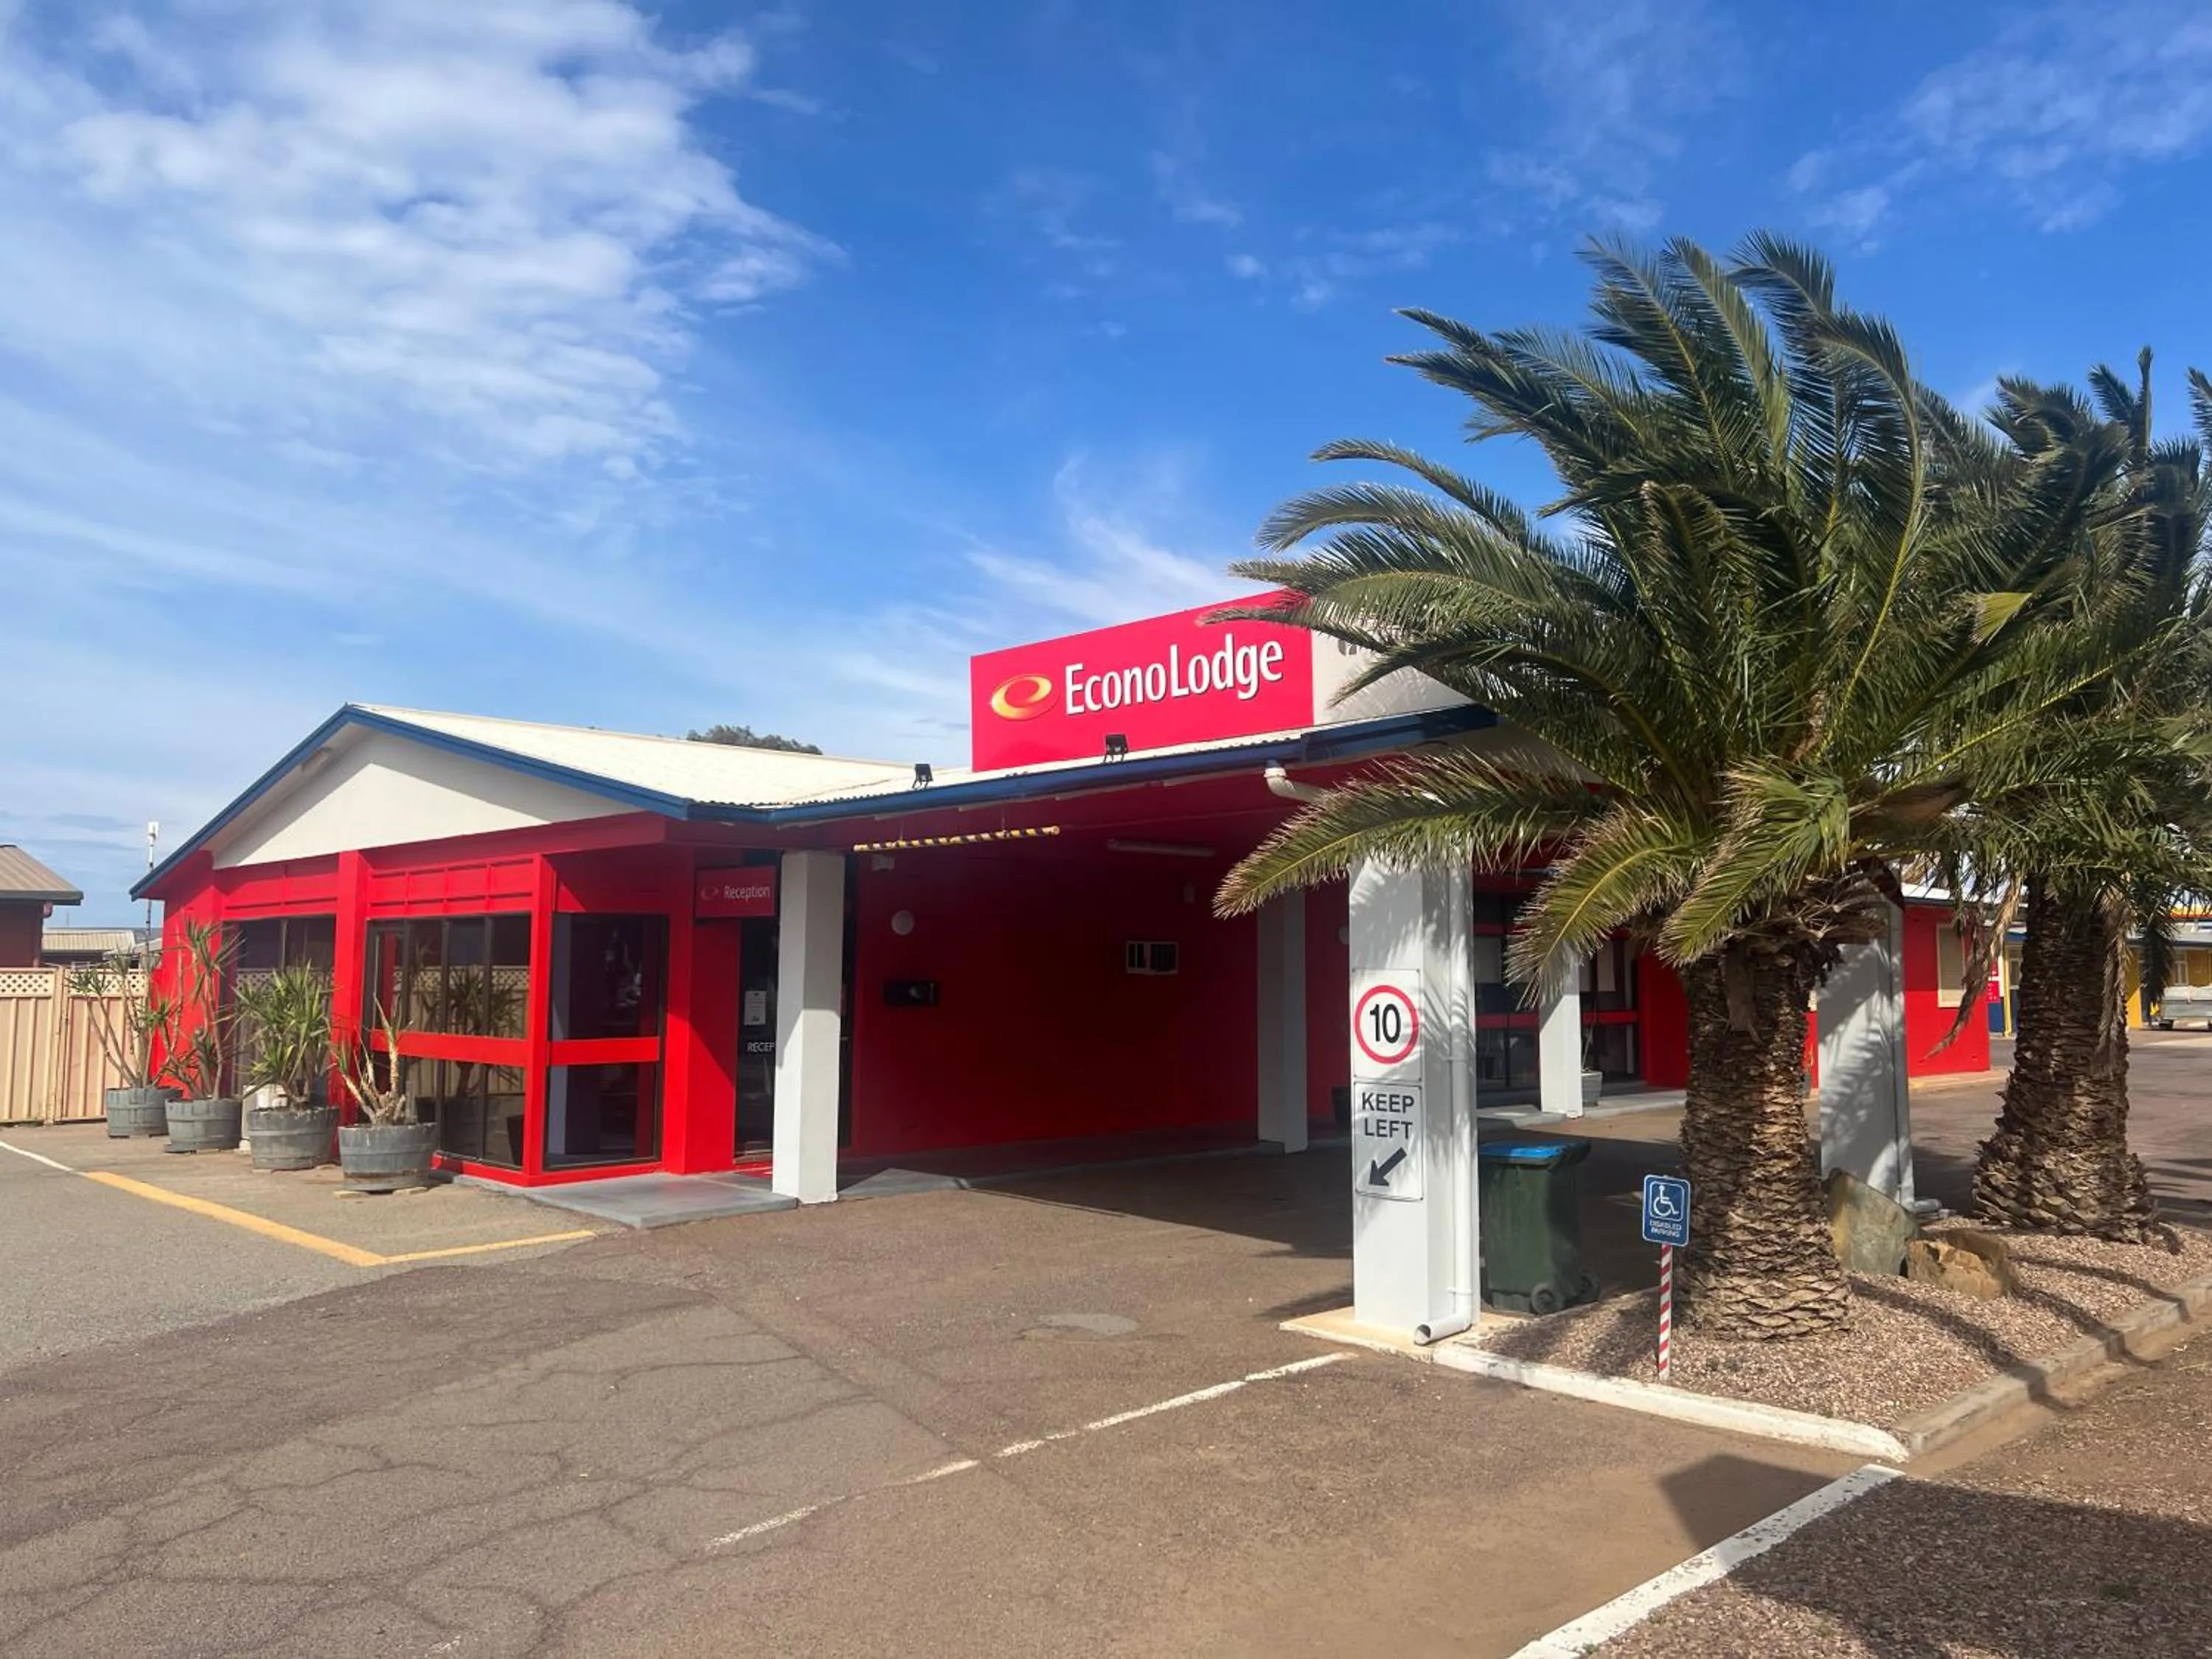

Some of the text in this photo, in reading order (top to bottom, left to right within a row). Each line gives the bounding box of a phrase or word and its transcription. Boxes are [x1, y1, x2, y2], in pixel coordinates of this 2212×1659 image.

[1065, 634, 1284, 714] EconoLodge
[724, 884, 771, 902] Reception
[1369, 1004, 1401, 1043] 10
[747, 1042, 775, 1052] RECEP
[1362, 1092, 1415, 1114] KEEP
[1364, 1119, 1413, 1140] LEFT
[1649, 1220, 1682, 1231] DISABLED
[1651, 1227, 1680, 1237] PARKING
